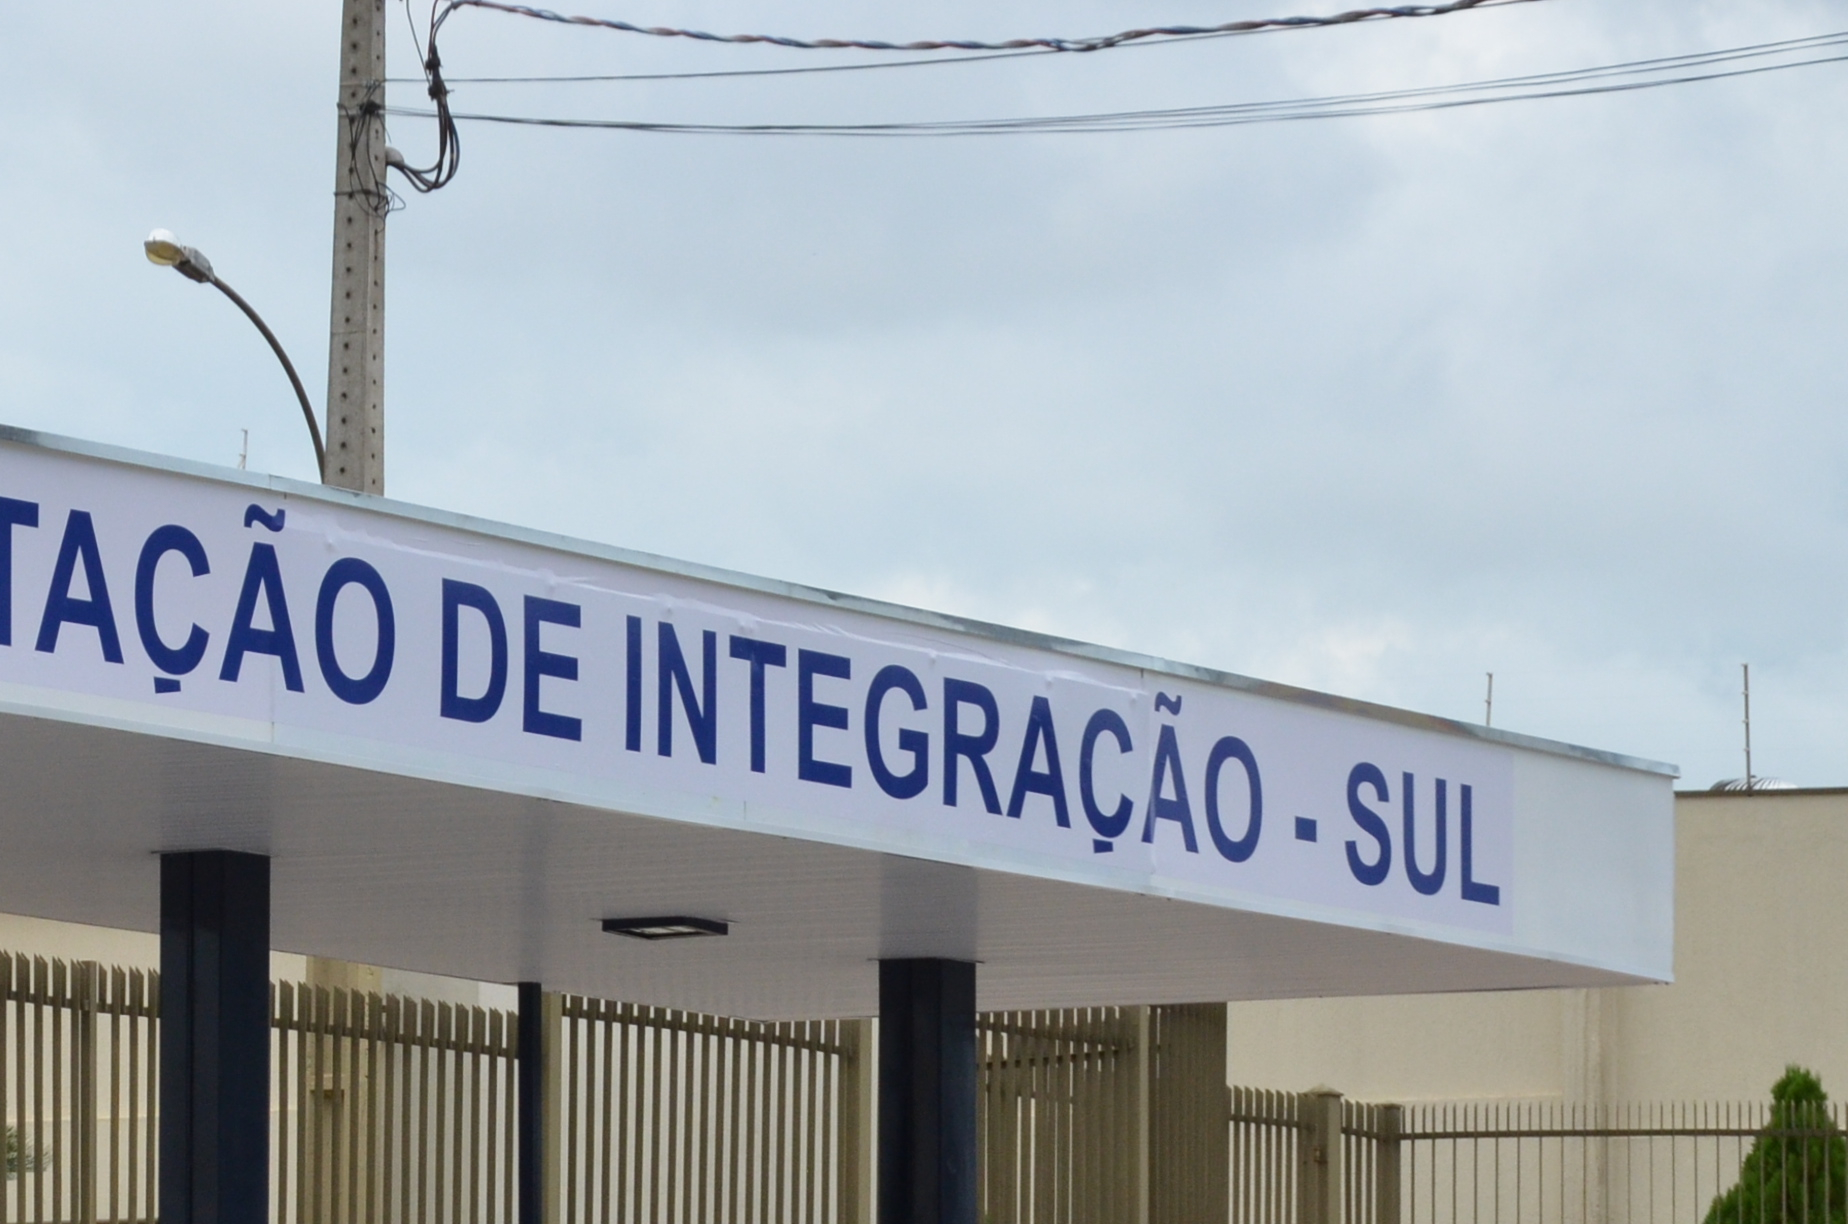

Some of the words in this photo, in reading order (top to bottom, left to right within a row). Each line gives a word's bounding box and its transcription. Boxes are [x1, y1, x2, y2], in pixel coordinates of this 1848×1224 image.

[440, 578, 582, 742] DE
[625, 615, 1263, 863] INTEGRAÇÃO
[1295, 816, 1317, 843] -
[1345, 762, 1500, 906] SUL
